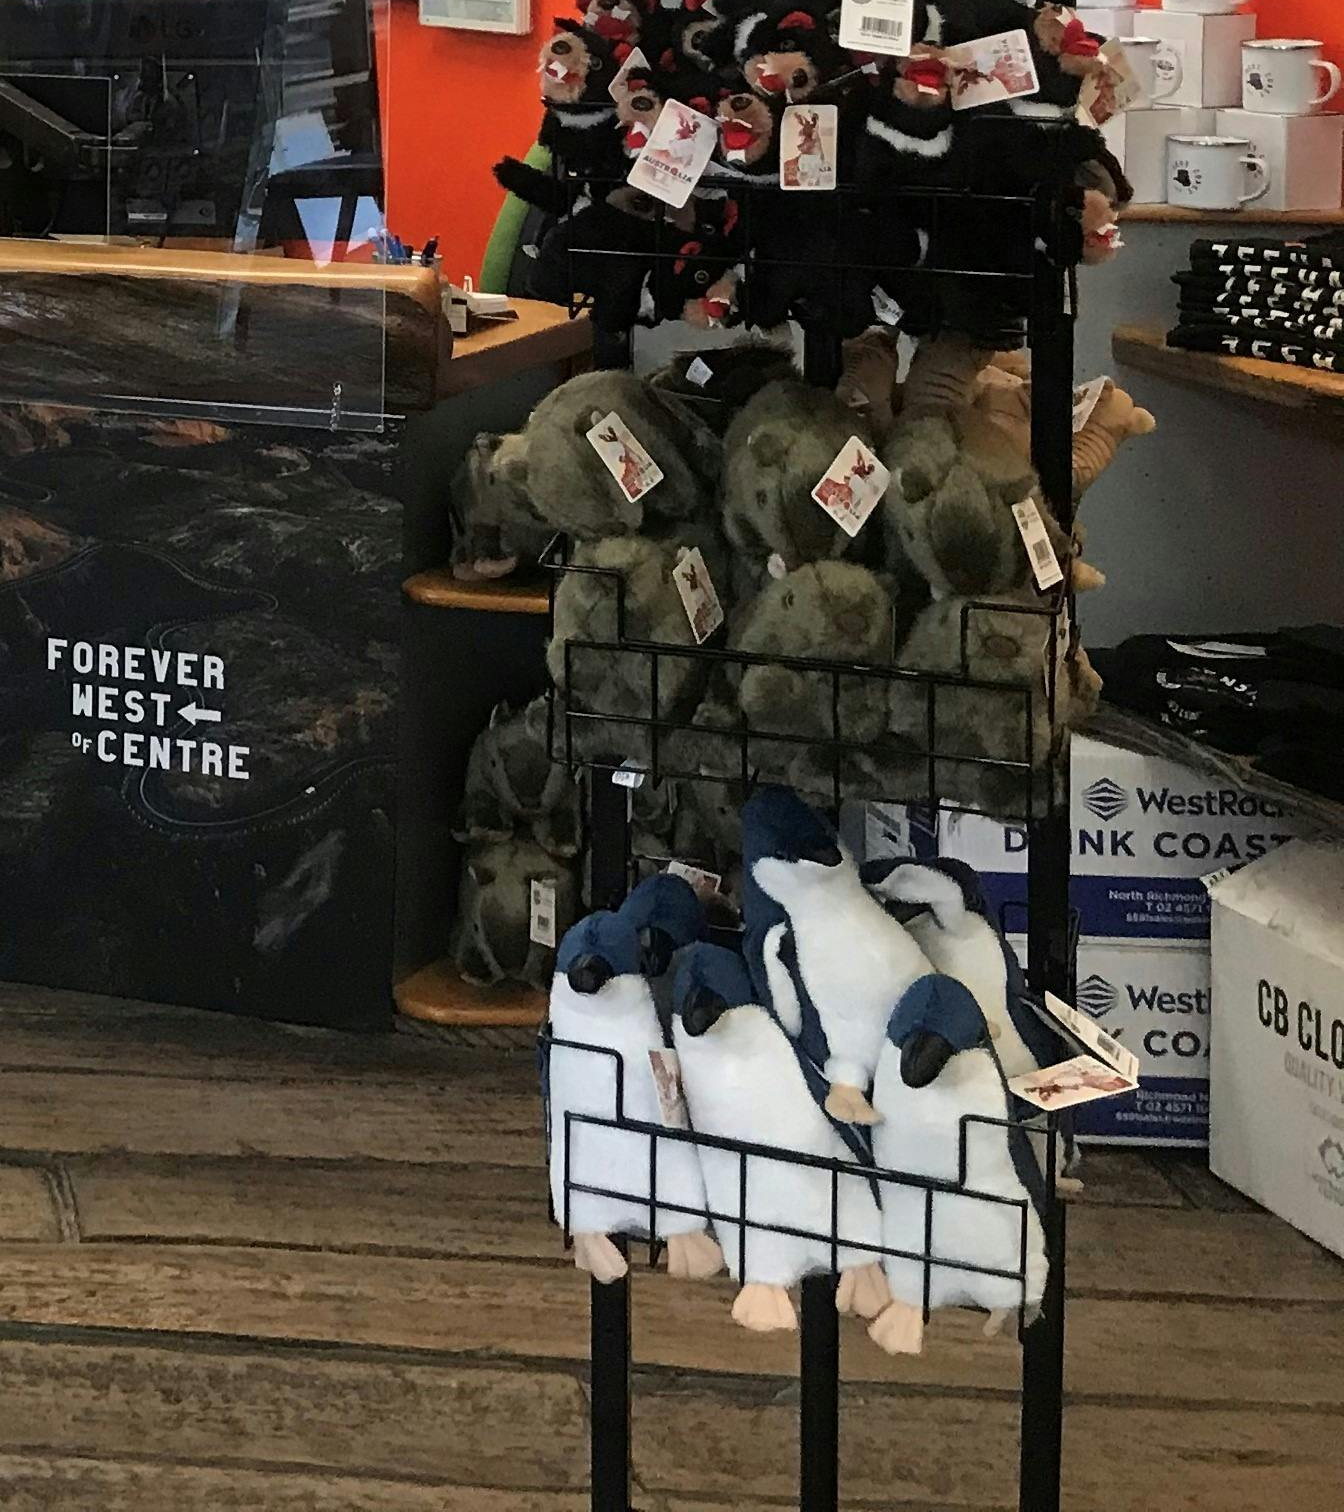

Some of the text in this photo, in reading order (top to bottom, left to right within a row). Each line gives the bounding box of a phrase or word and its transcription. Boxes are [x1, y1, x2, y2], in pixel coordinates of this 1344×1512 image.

[47, 637, 226, 690] FOREVER
[72, 683, 172, 728] WEST
[71, 731, 252, 781] OF CENTRE
[1136, 787, 1295, 817] WestRoc
[1003, 826, 1136, 858] DNK
[1108, 890, 1144, 901] North
[1258, 978, 1290, 1038] CB
[1142, 1029, 1210, 1058] CO
